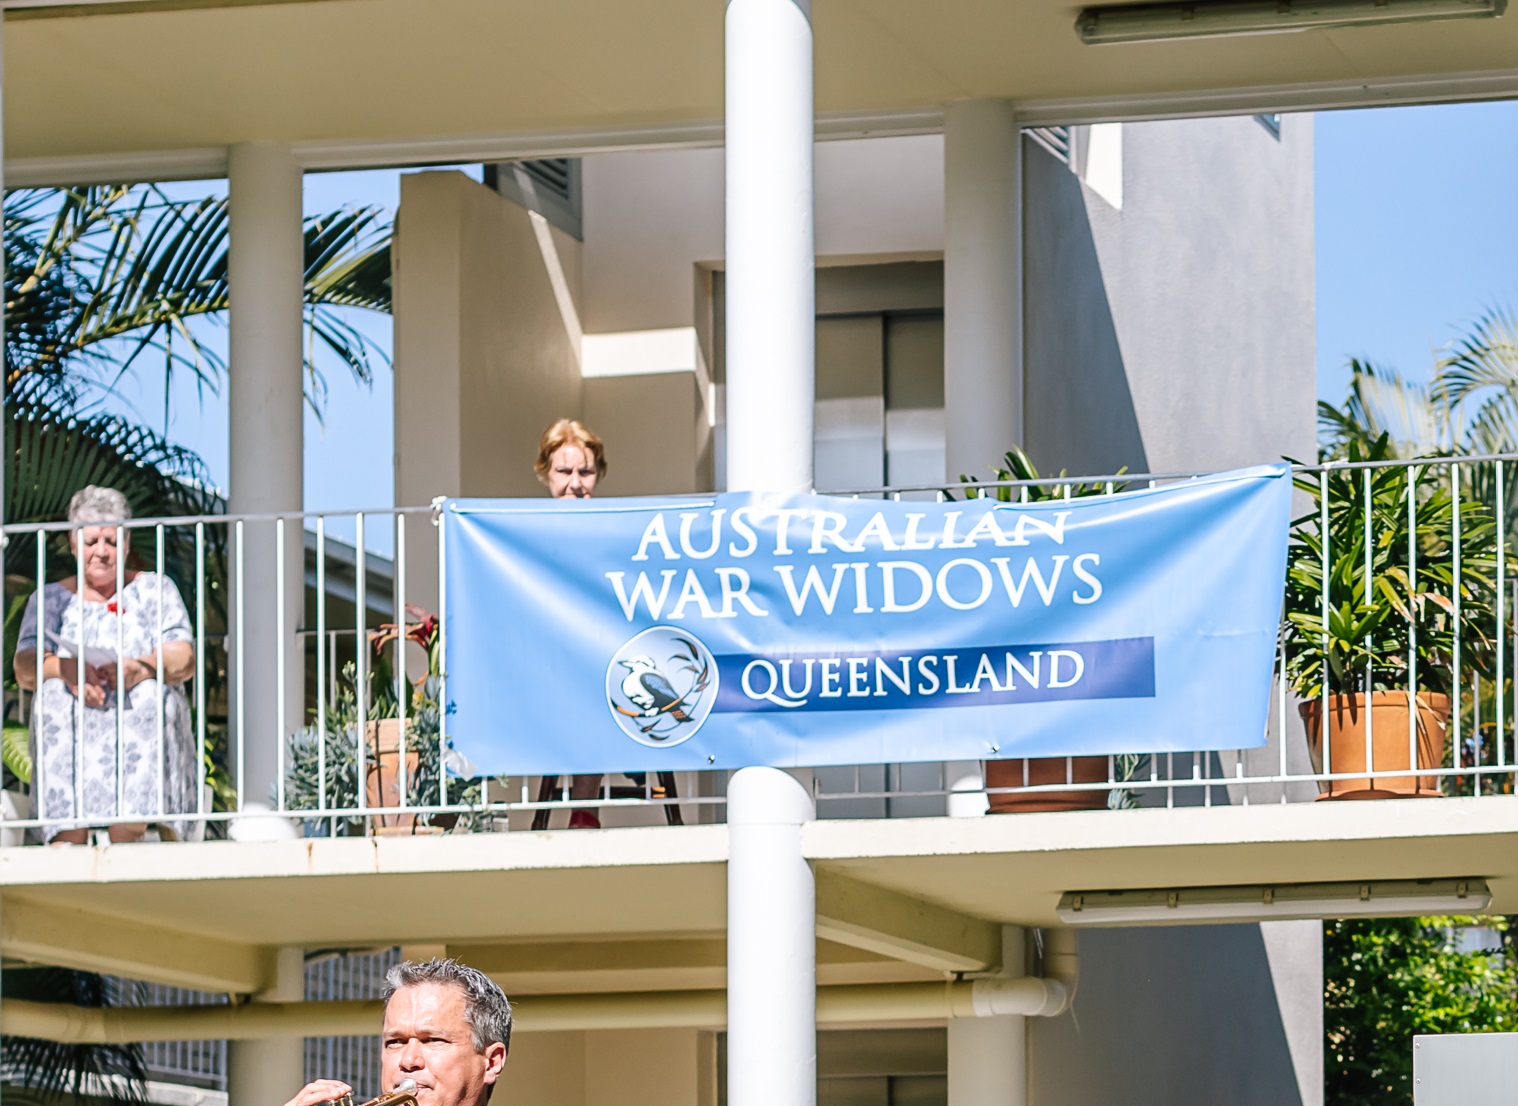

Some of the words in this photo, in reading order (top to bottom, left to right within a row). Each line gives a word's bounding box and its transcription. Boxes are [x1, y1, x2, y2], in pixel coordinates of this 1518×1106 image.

[632, 510, 1072, 561] AUSTRALIAN
[604, 566, 770, 622] WAR
[773, 553, 1103, 617] WIDOWS
[741, 649, 1085, 708] QUEENSLAND
